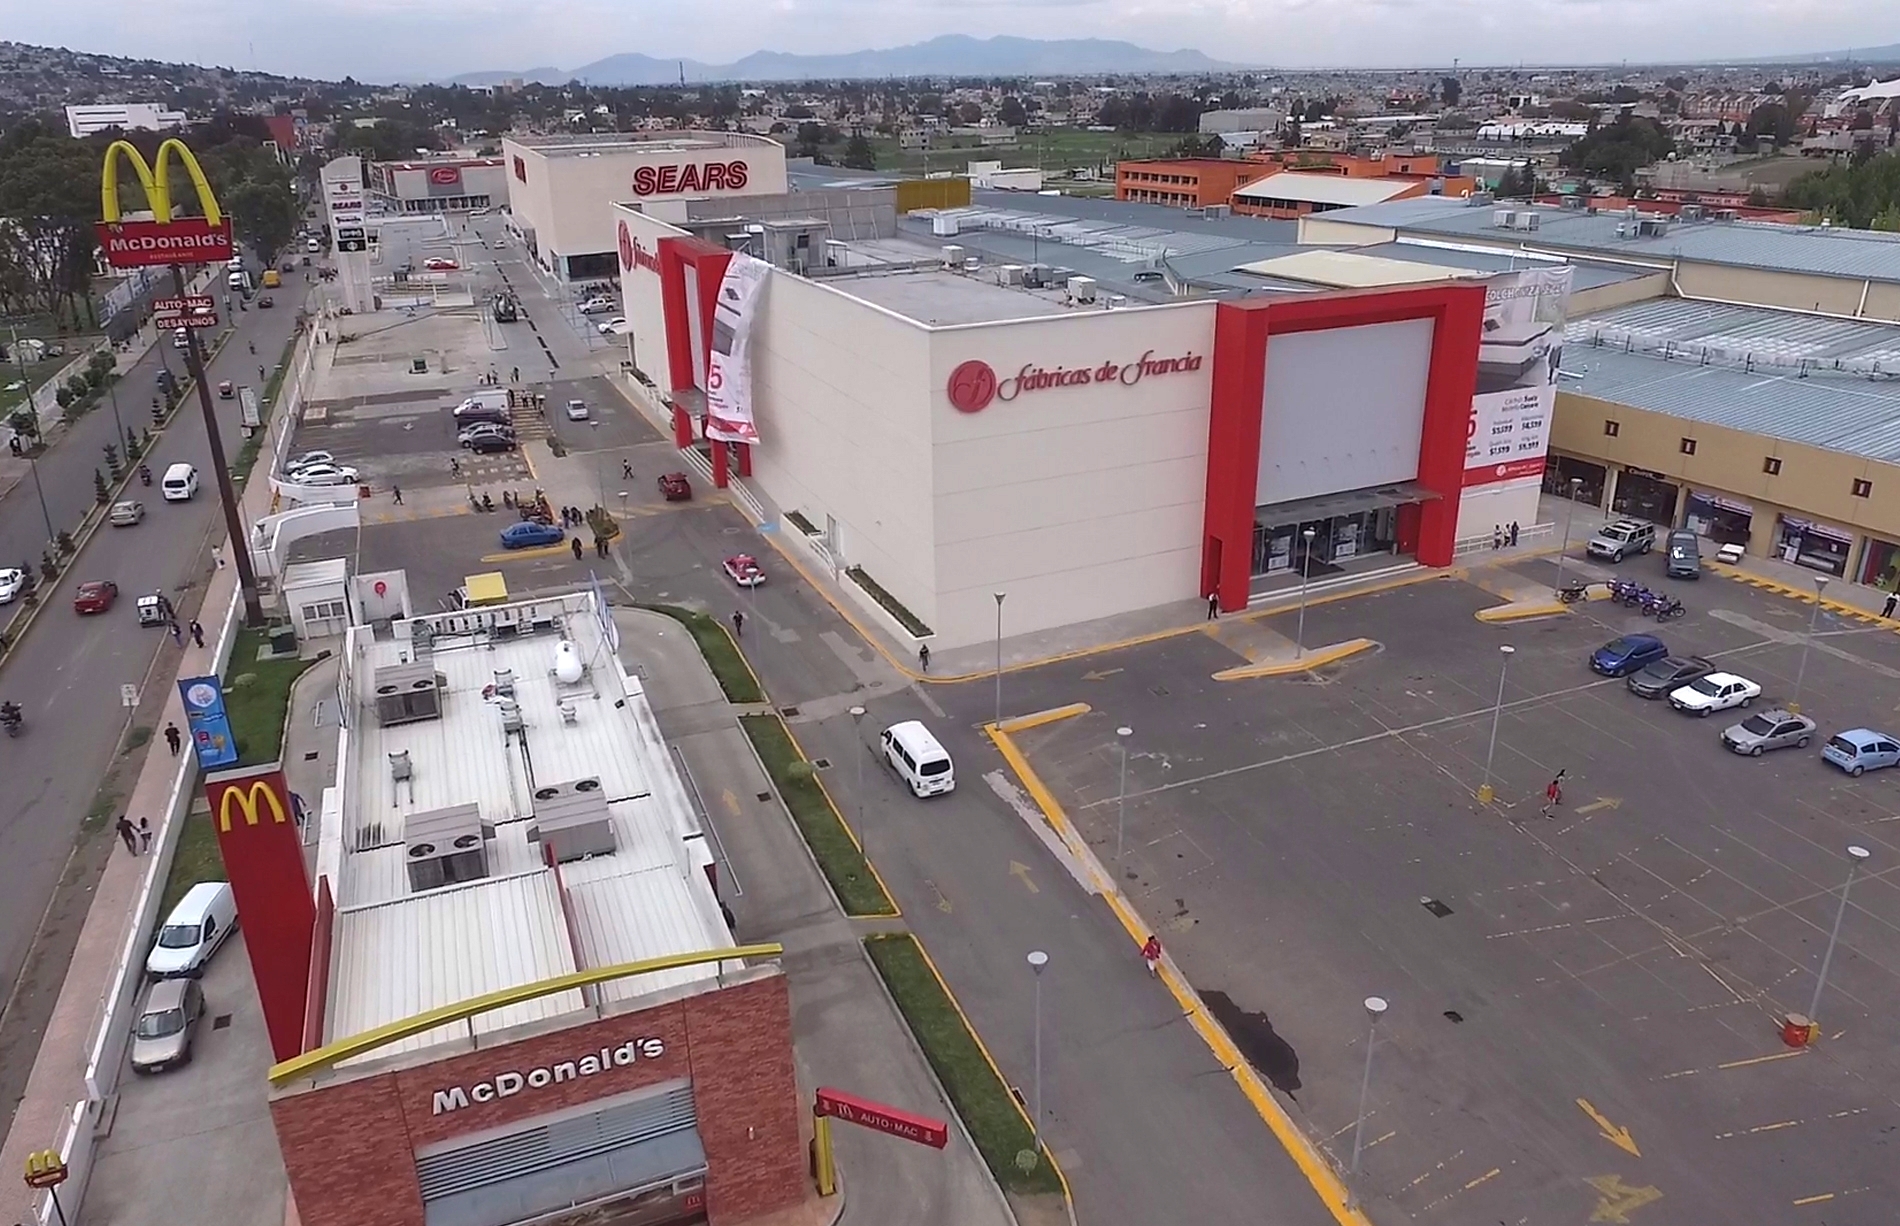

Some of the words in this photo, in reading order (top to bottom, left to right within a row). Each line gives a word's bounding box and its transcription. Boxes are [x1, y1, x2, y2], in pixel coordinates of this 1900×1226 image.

[633, 160, 749, 196] SEARS
[110, 234, 228, 252] McDonald's
[154, 299, 212, 310] AUTO-MAC
[157, 316, 216, 329] DESAYUNOS
[1095, 361, 1119, 382] de
[432, 1036, 666, 1116] McDonald's
